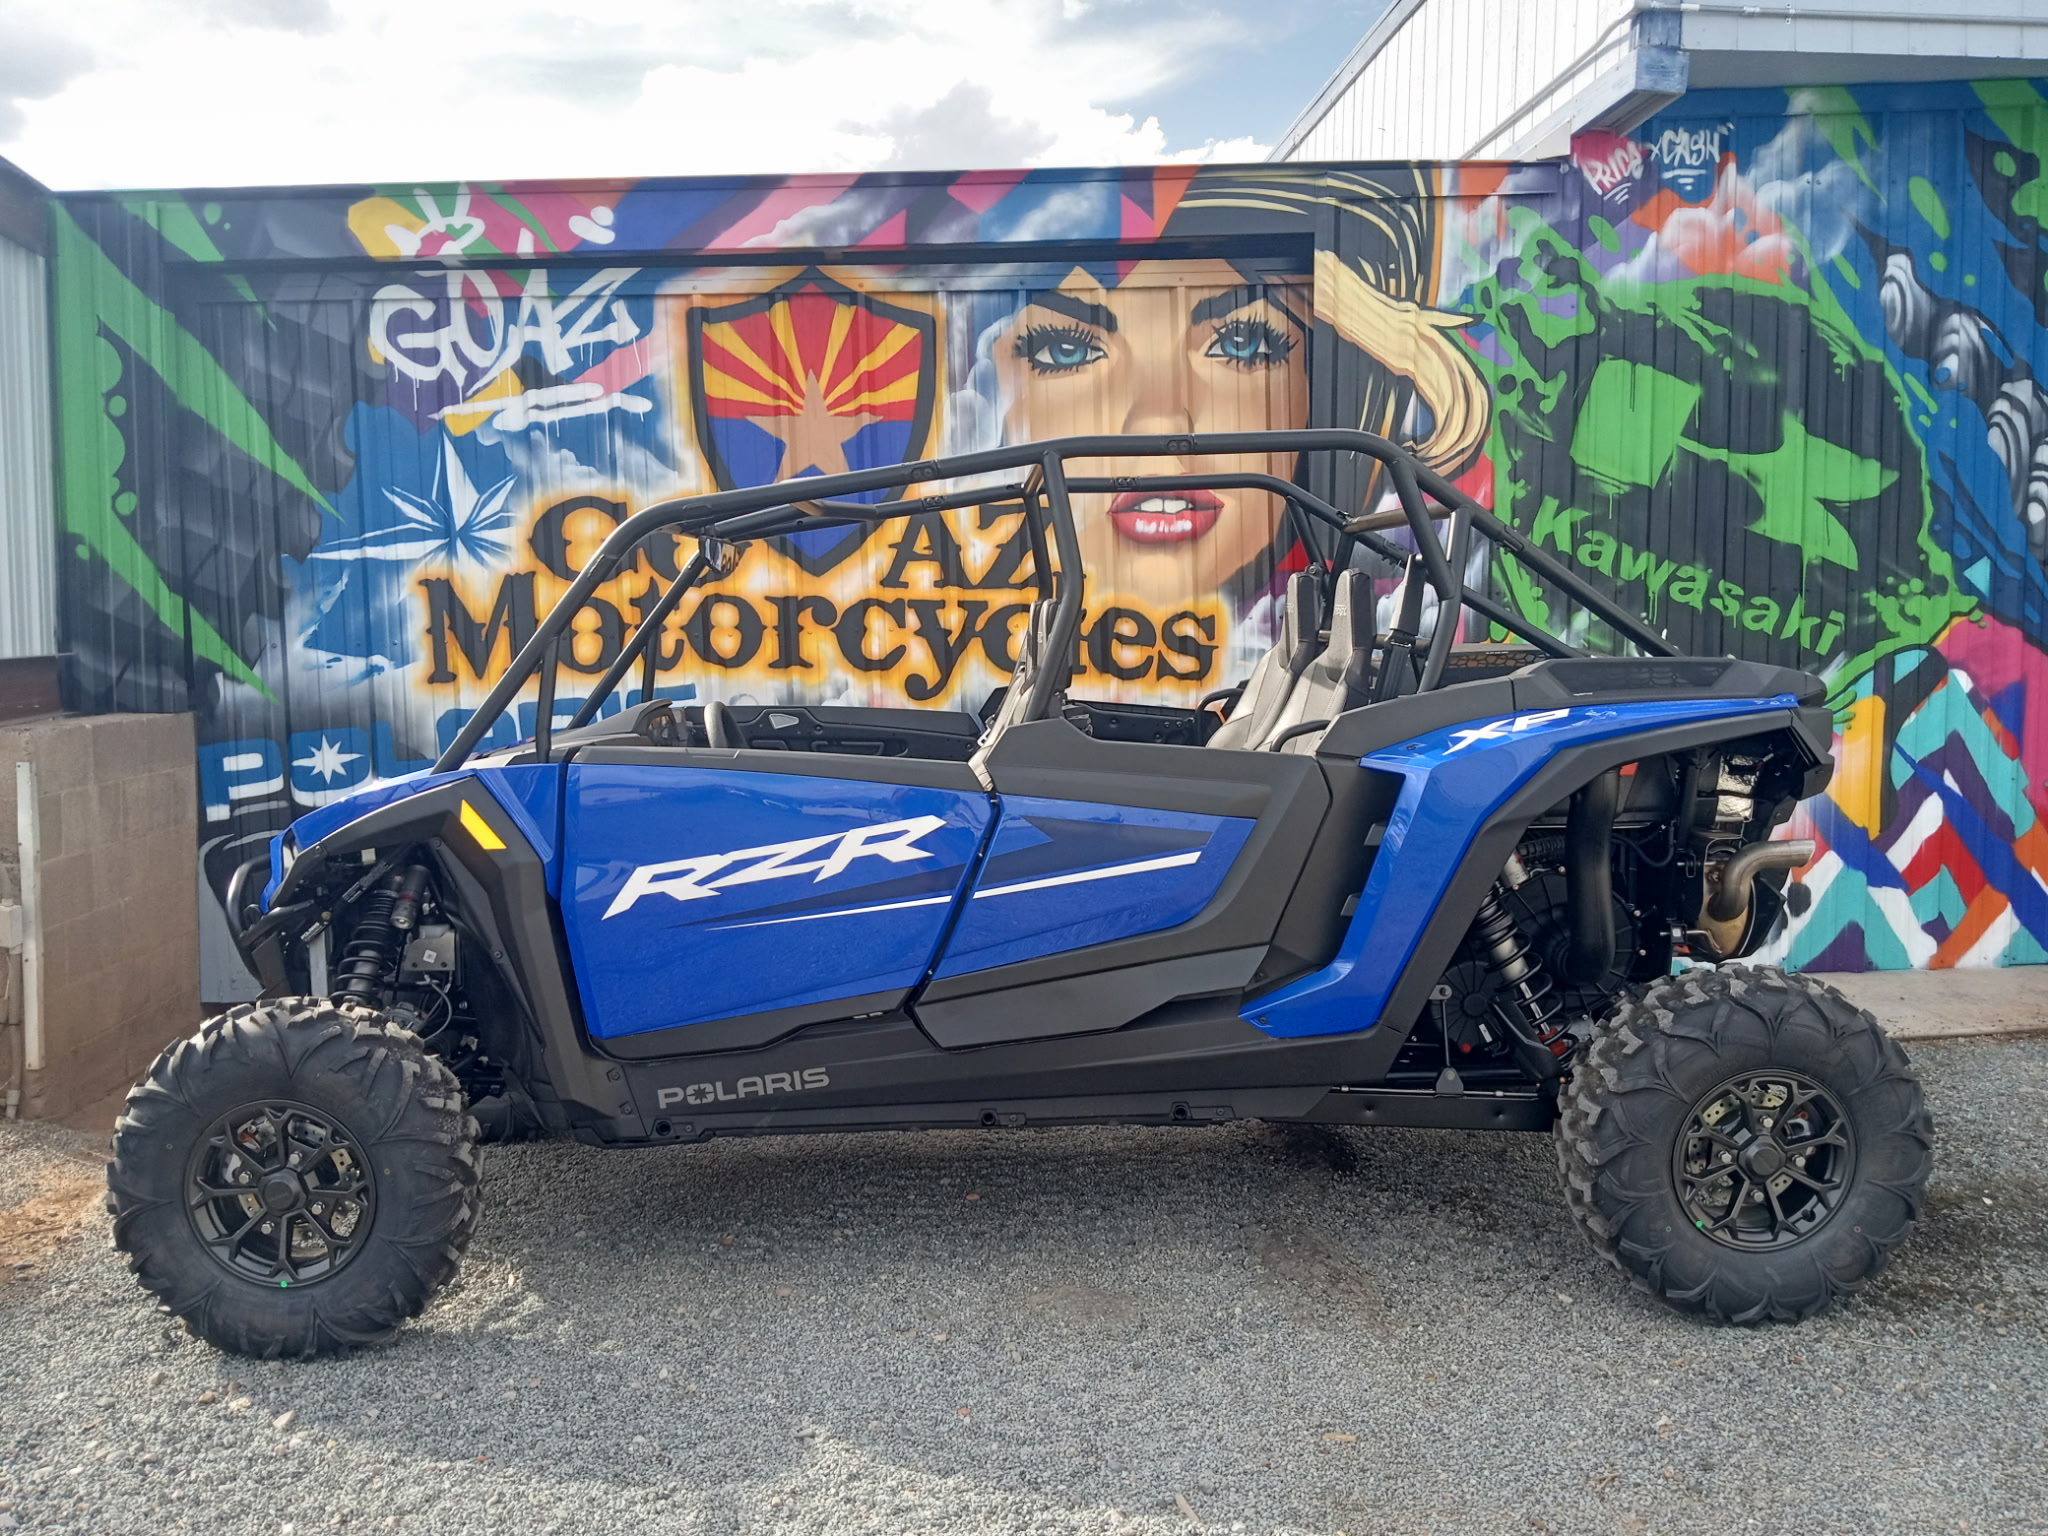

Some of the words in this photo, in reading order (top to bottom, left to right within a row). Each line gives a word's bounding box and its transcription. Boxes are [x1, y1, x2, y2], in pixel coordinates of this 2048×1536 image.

[880, 501, 1054, 590] AZ
[1528, 495, 1846, 656] Kawasaki
[198, 684, 697, 808] POLAR
[1442, 708, 1571, 756] XP
[601, 814, 948, 921] RZR
[657, 1067, 831, 1110] POLARIS
